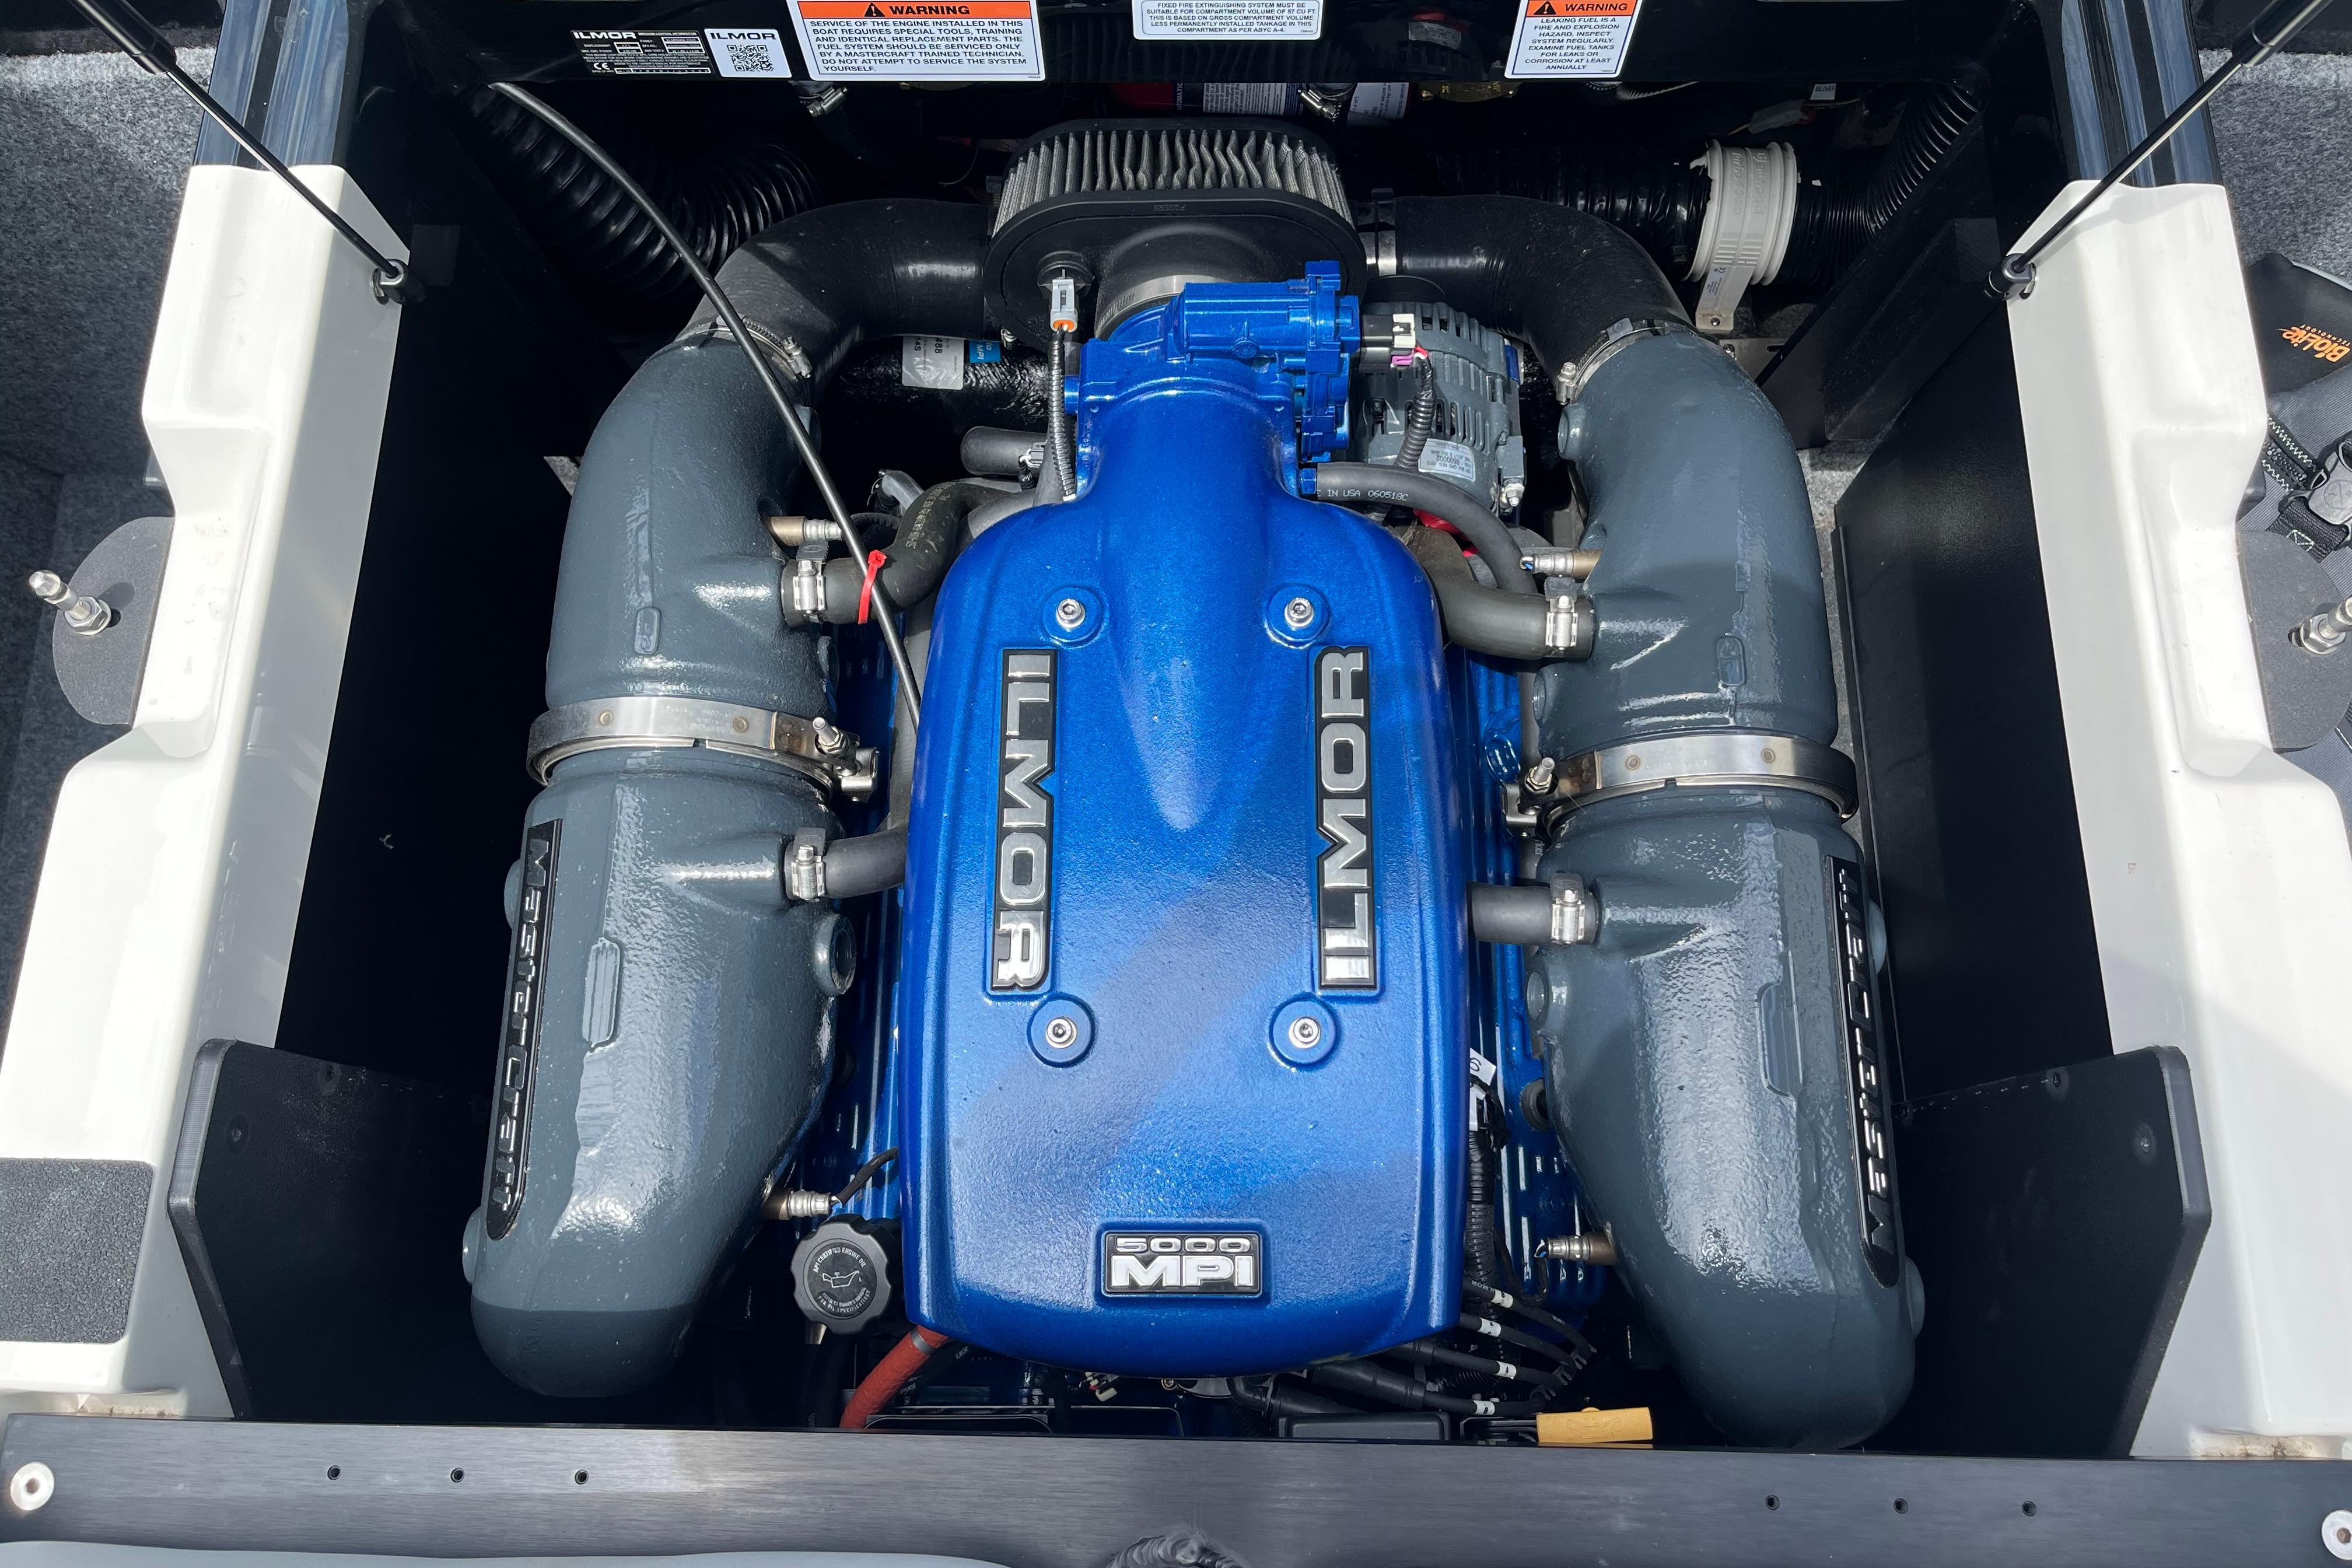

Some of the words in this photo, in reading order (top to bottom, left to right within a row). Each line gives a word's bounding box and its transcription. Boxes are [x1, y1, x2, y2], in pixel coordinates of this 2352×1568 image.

[888, 6, 970, 15] WARNING
[1565, 3, 1628, 11] WARNING
[572, 32, 637, 40] ILMOR
[2300, 324, 2351, 346] TECHNOLOGY
[1327, 489, 1338, 498] IN
[1367, 489, 1409, 501] 060518C
[998, 653, 1051, 986] ILMOR
[1321, 650, 1370, 980] ILMOR
[492, 838, 549, 1211] MasterCraft
[1839, 869, 1898, 1256] MasterCraft
[1116, 1236, 1252, 1253] 5000
[817, 1247, 841, 1264] CERTIFIED
[842, 1247, 860, 1261] ENGINE
[858, 1258, 867, 1268] OIL
[1111, 1254, 1254, 1287] MPI
